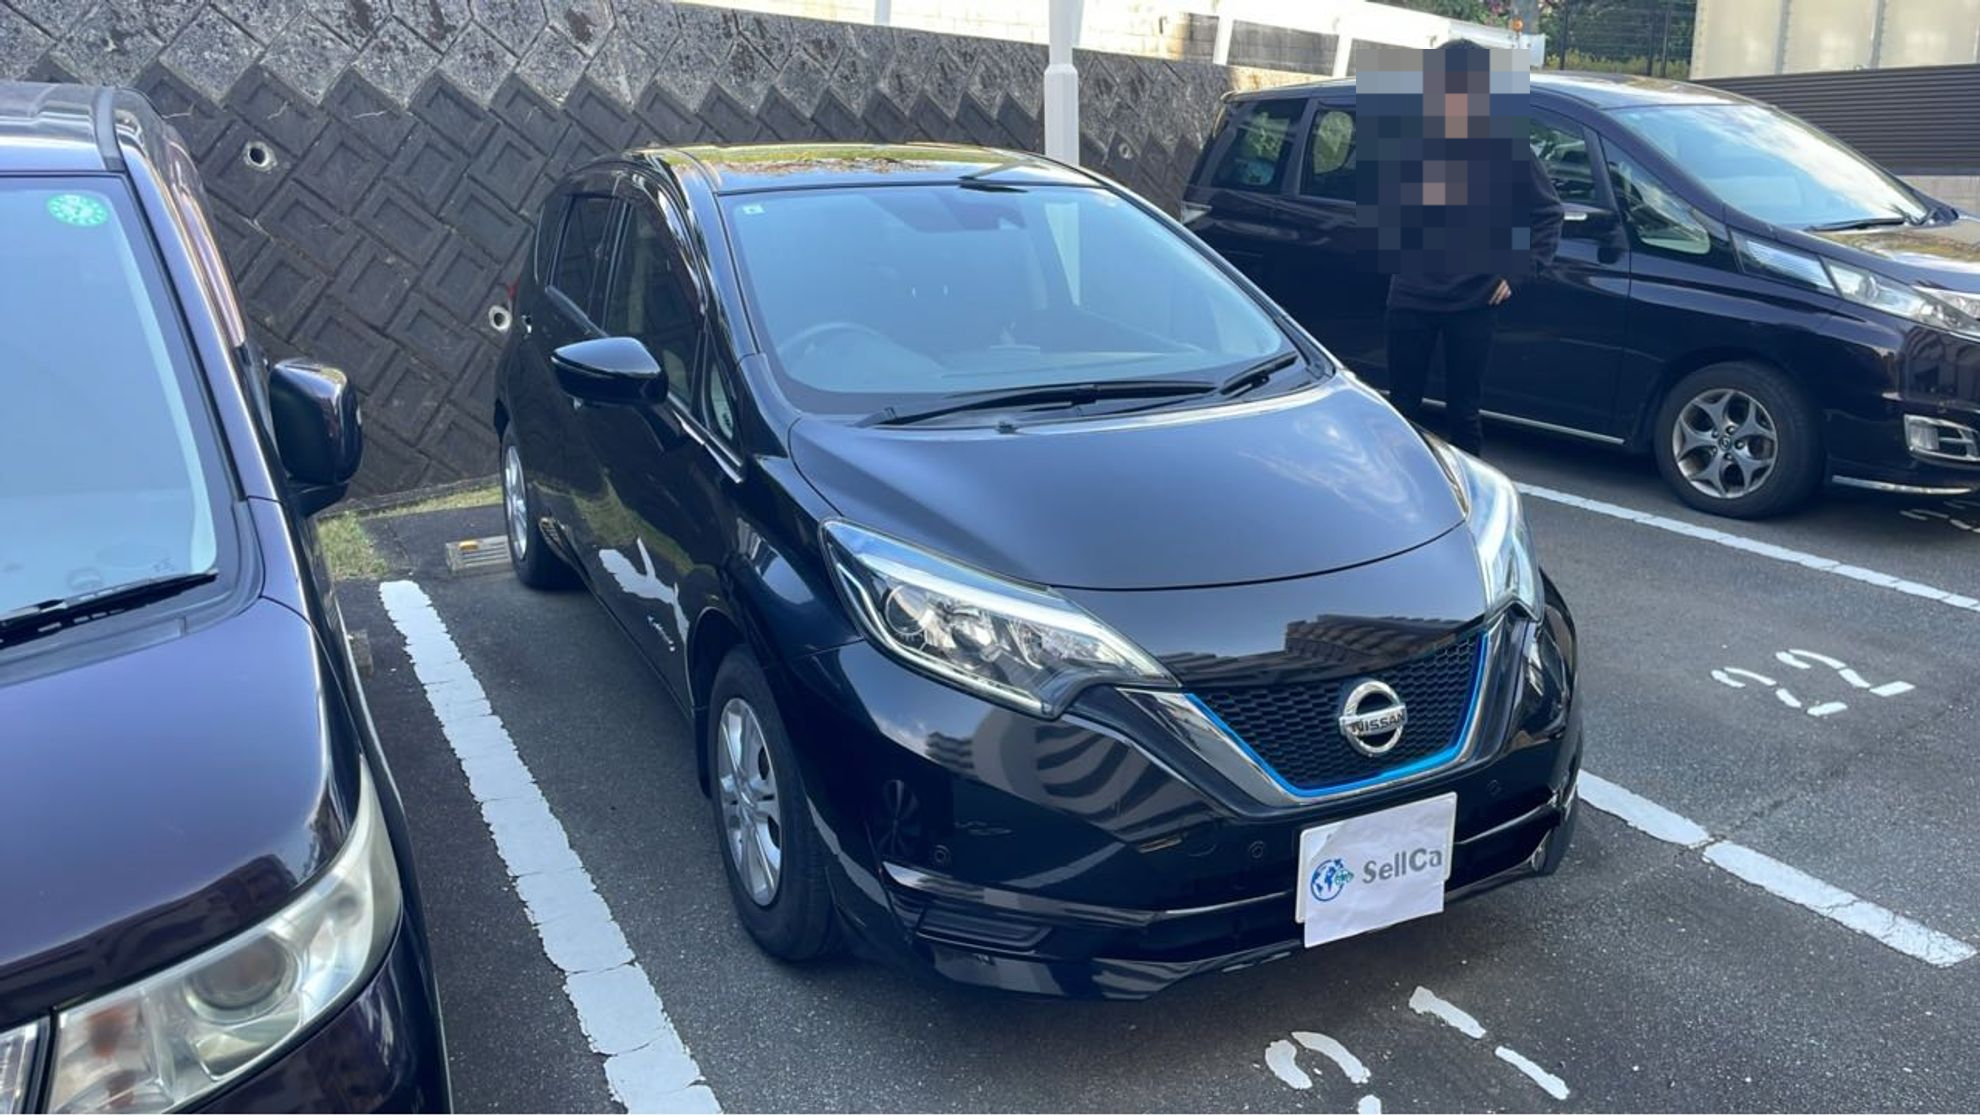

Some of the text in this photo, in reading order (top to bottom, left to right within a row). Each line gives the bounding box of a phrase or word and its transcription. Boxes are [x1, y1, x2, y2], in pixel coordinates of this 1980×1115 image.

[1710, 649, 1916, 716] 22
[1352, 711, 1405, 732] NISSAN
[1362, 848, 1442, 884] SellCa
